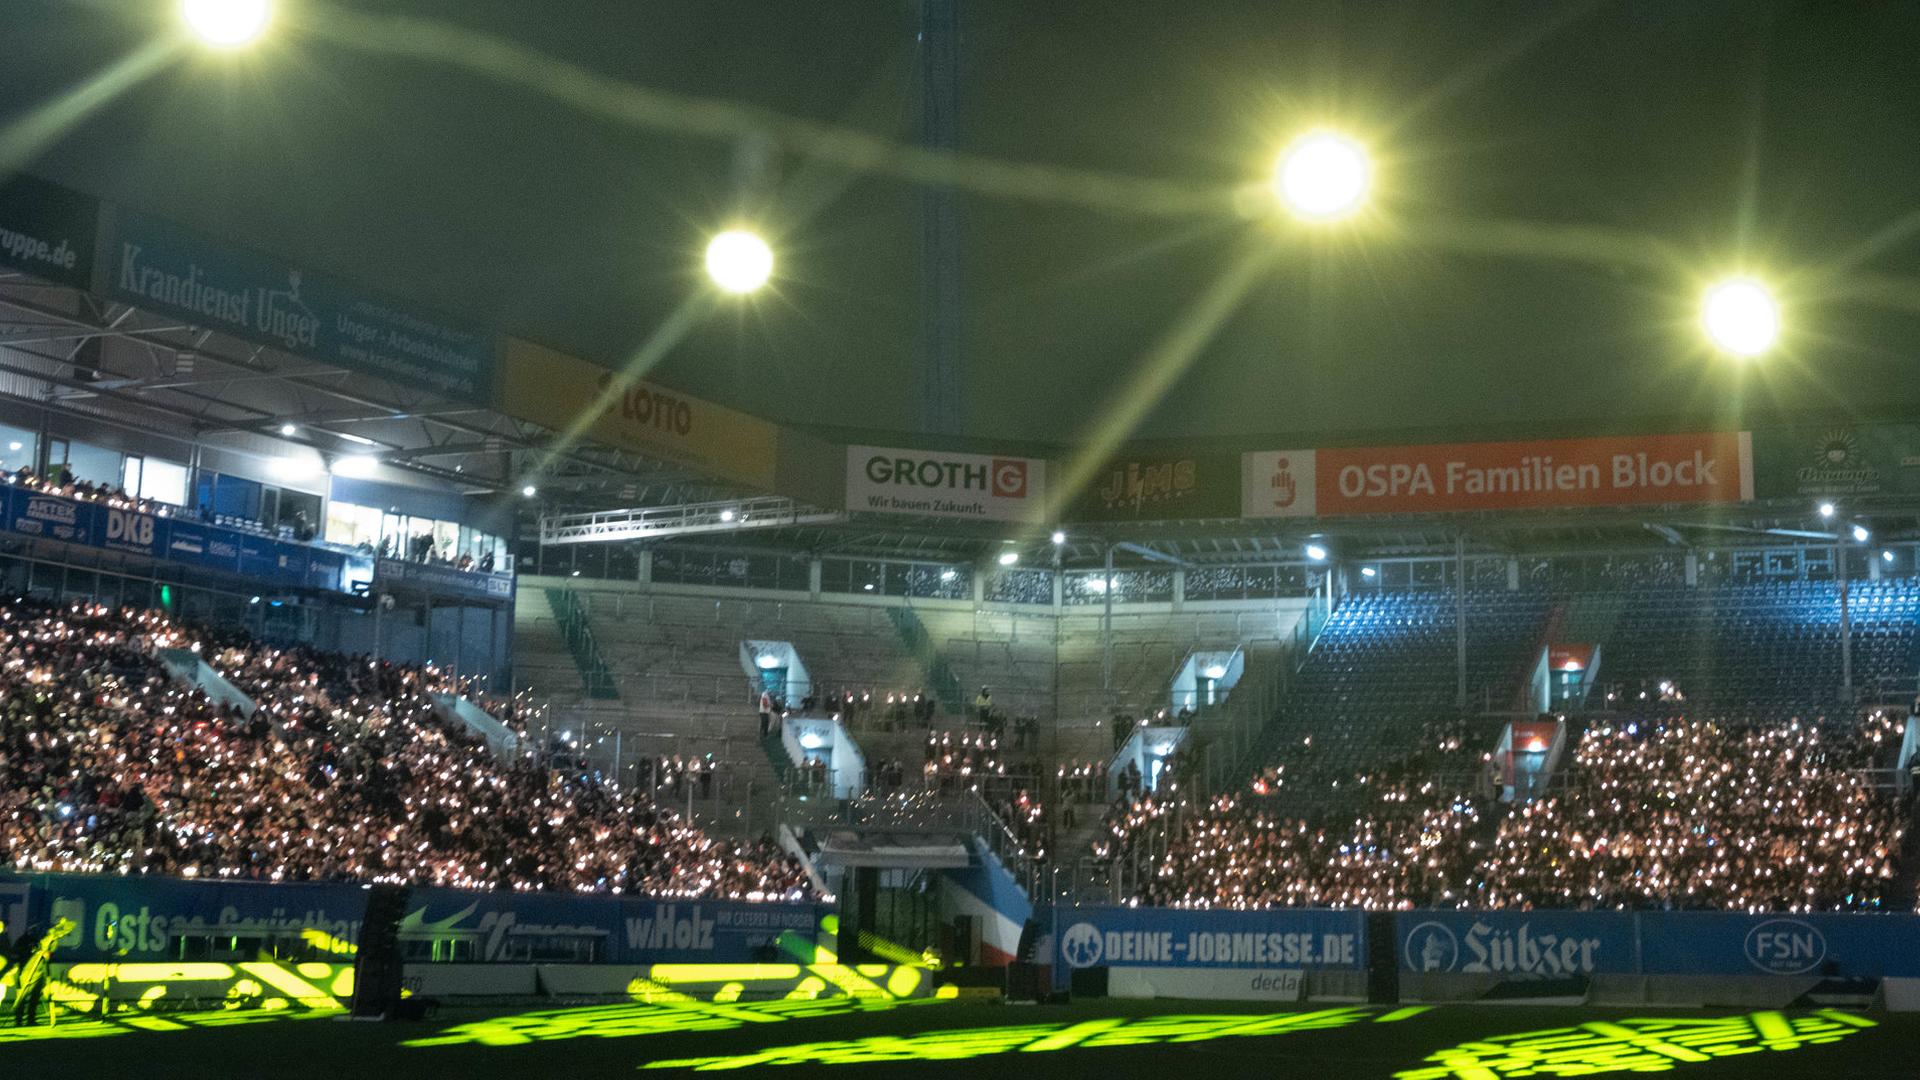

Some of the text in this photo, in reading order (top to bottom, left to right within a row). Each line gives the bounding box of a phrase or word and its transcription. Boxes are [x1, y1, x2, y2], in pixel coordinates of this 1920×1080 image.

[119, 241, 250, 327] Krandienst
[256, 287, 321, 347] Unger
[337, 313, 378, 343] Unger
[622, 388, 692, 437] LOTTO
[866, 456, 1024, 494] GROTH G
[1338, 450, 1718, 498] OSPA Familien Block
[868, 496, 987, 515] Wir bauen Zukunft.
[106, 509, 155, 546] DKB
[1105, 930, 1355, 965] DEINE-JOBMESSE.DE
[1756, 932, 1815, 959] FSN
